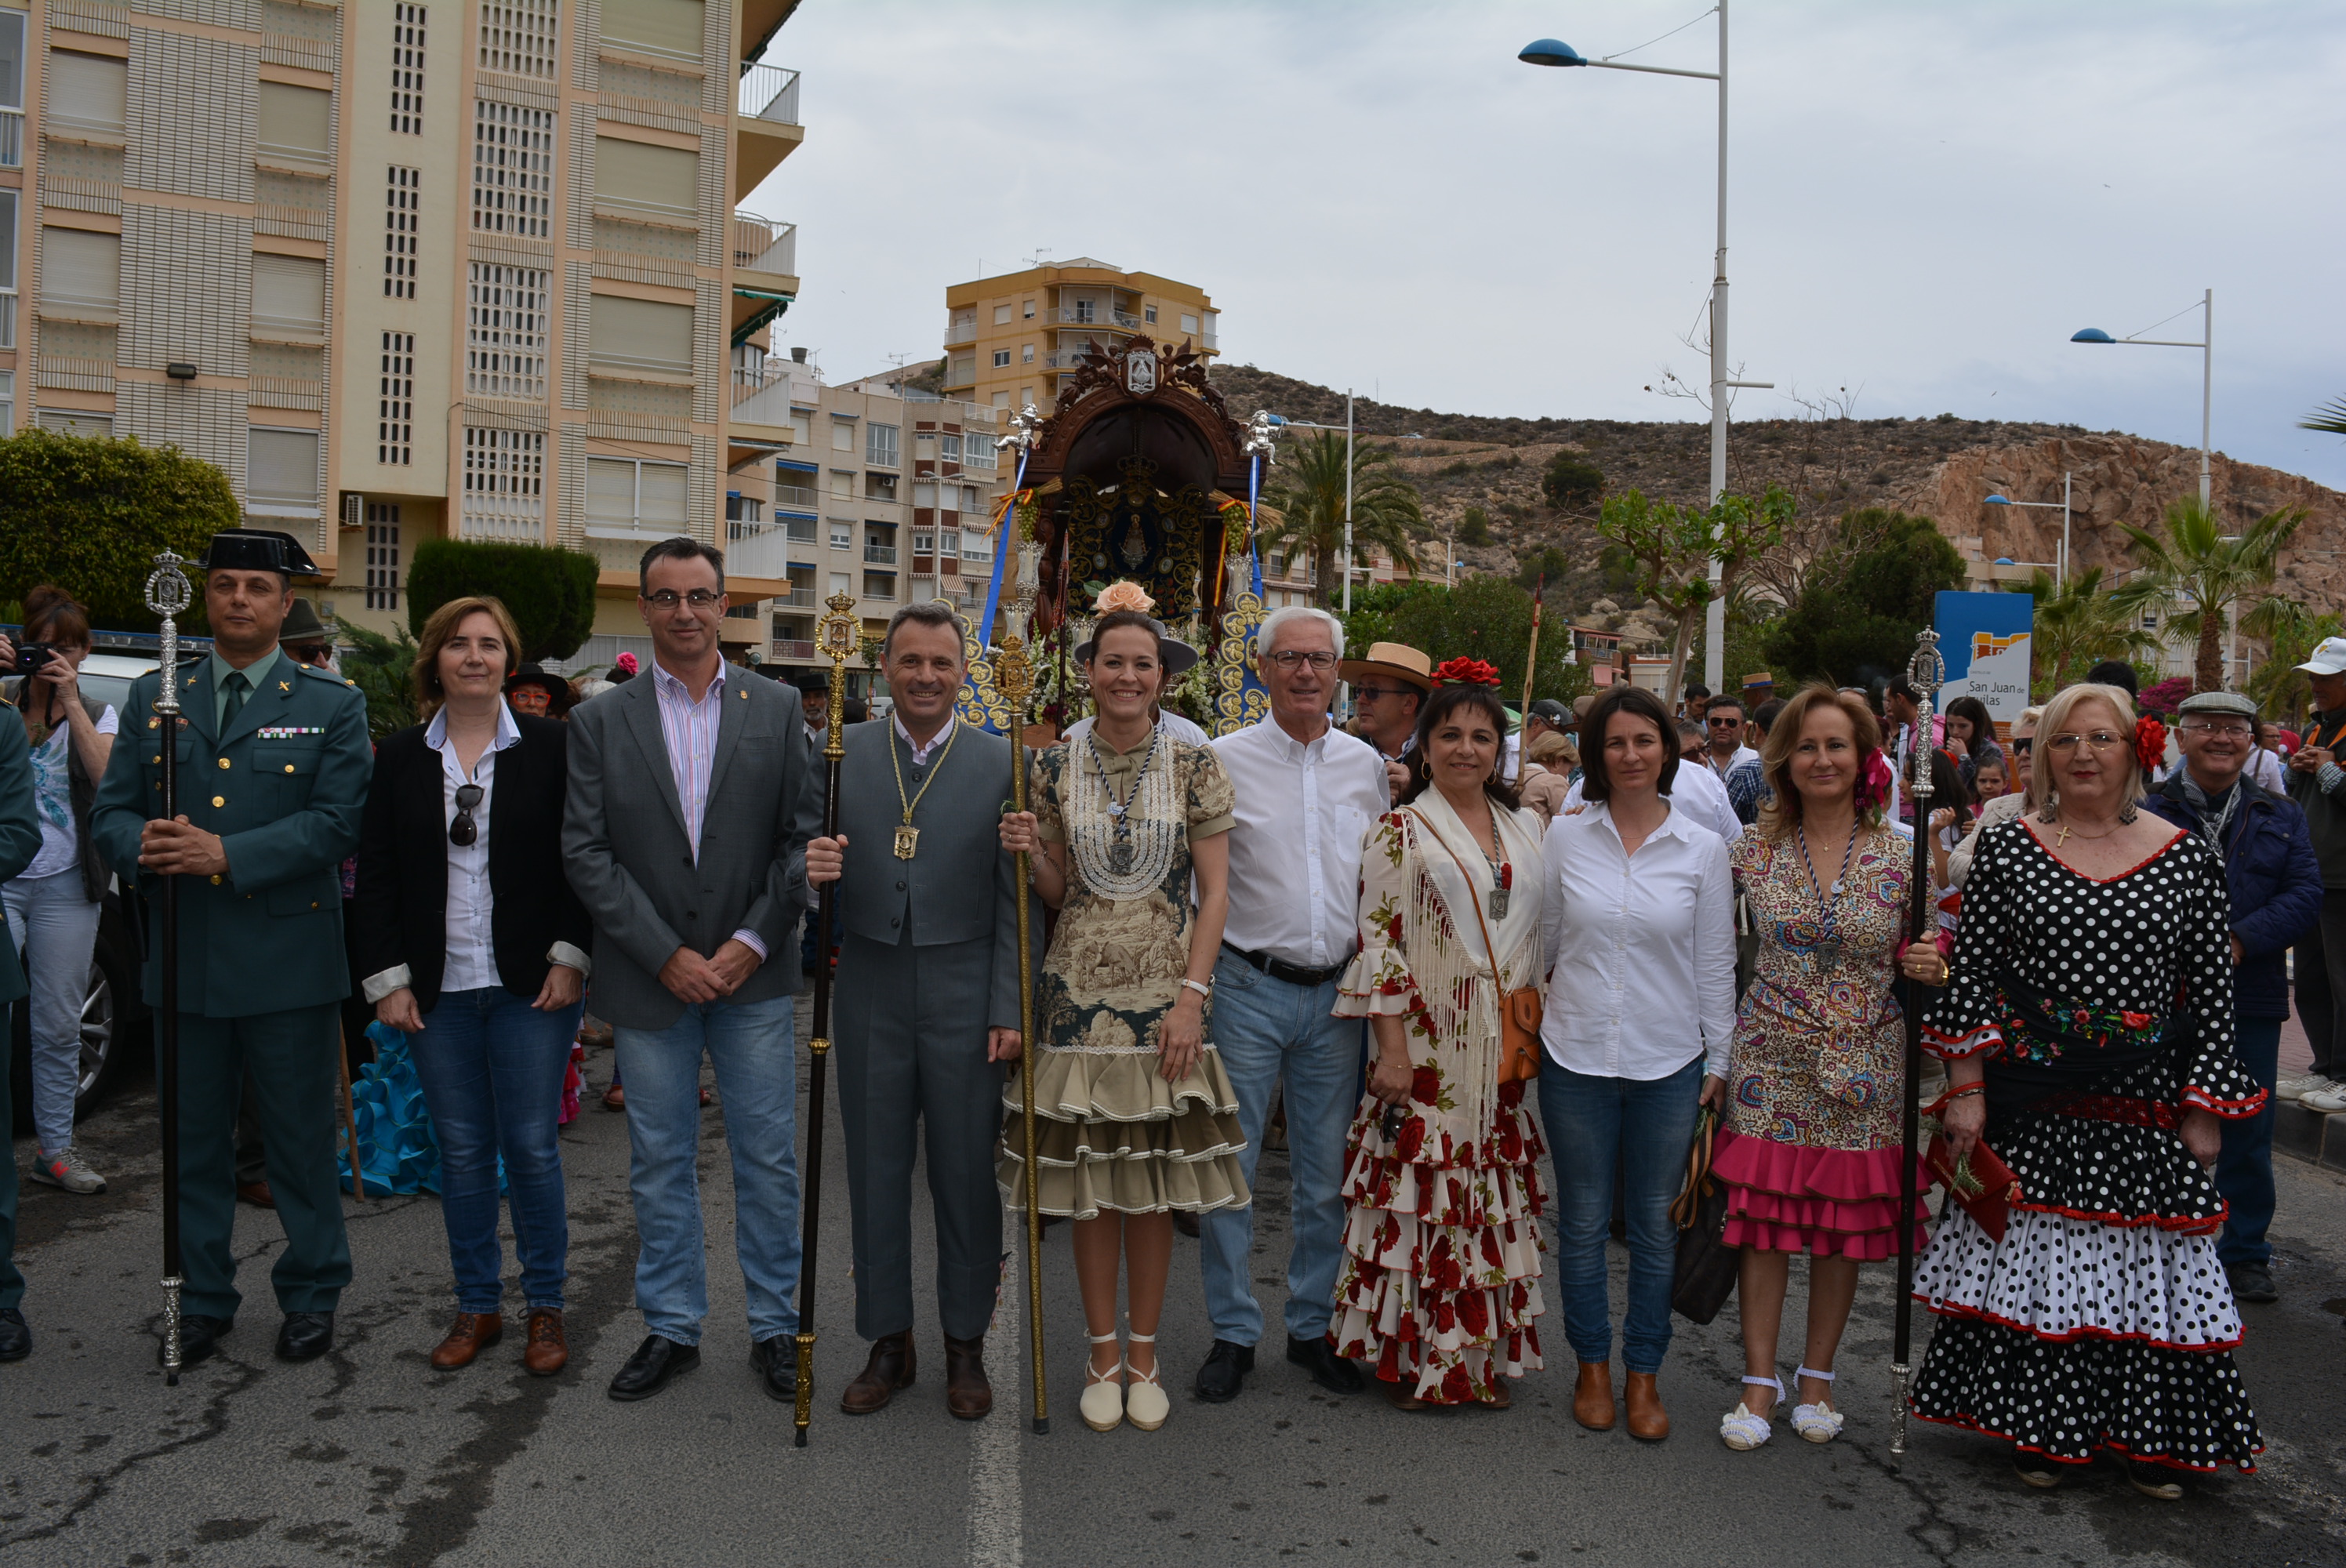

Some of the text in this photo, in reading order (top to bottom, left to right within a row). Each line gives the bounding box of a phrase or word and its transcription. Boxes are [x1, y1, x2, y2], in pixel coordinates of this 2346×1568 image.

[1969, 681, 1988, 692] San
[1991, 681, 2016, 693] Juan
[1966, 691, 2000, 706] ilas
[49, 1161, 69, 1179] N
